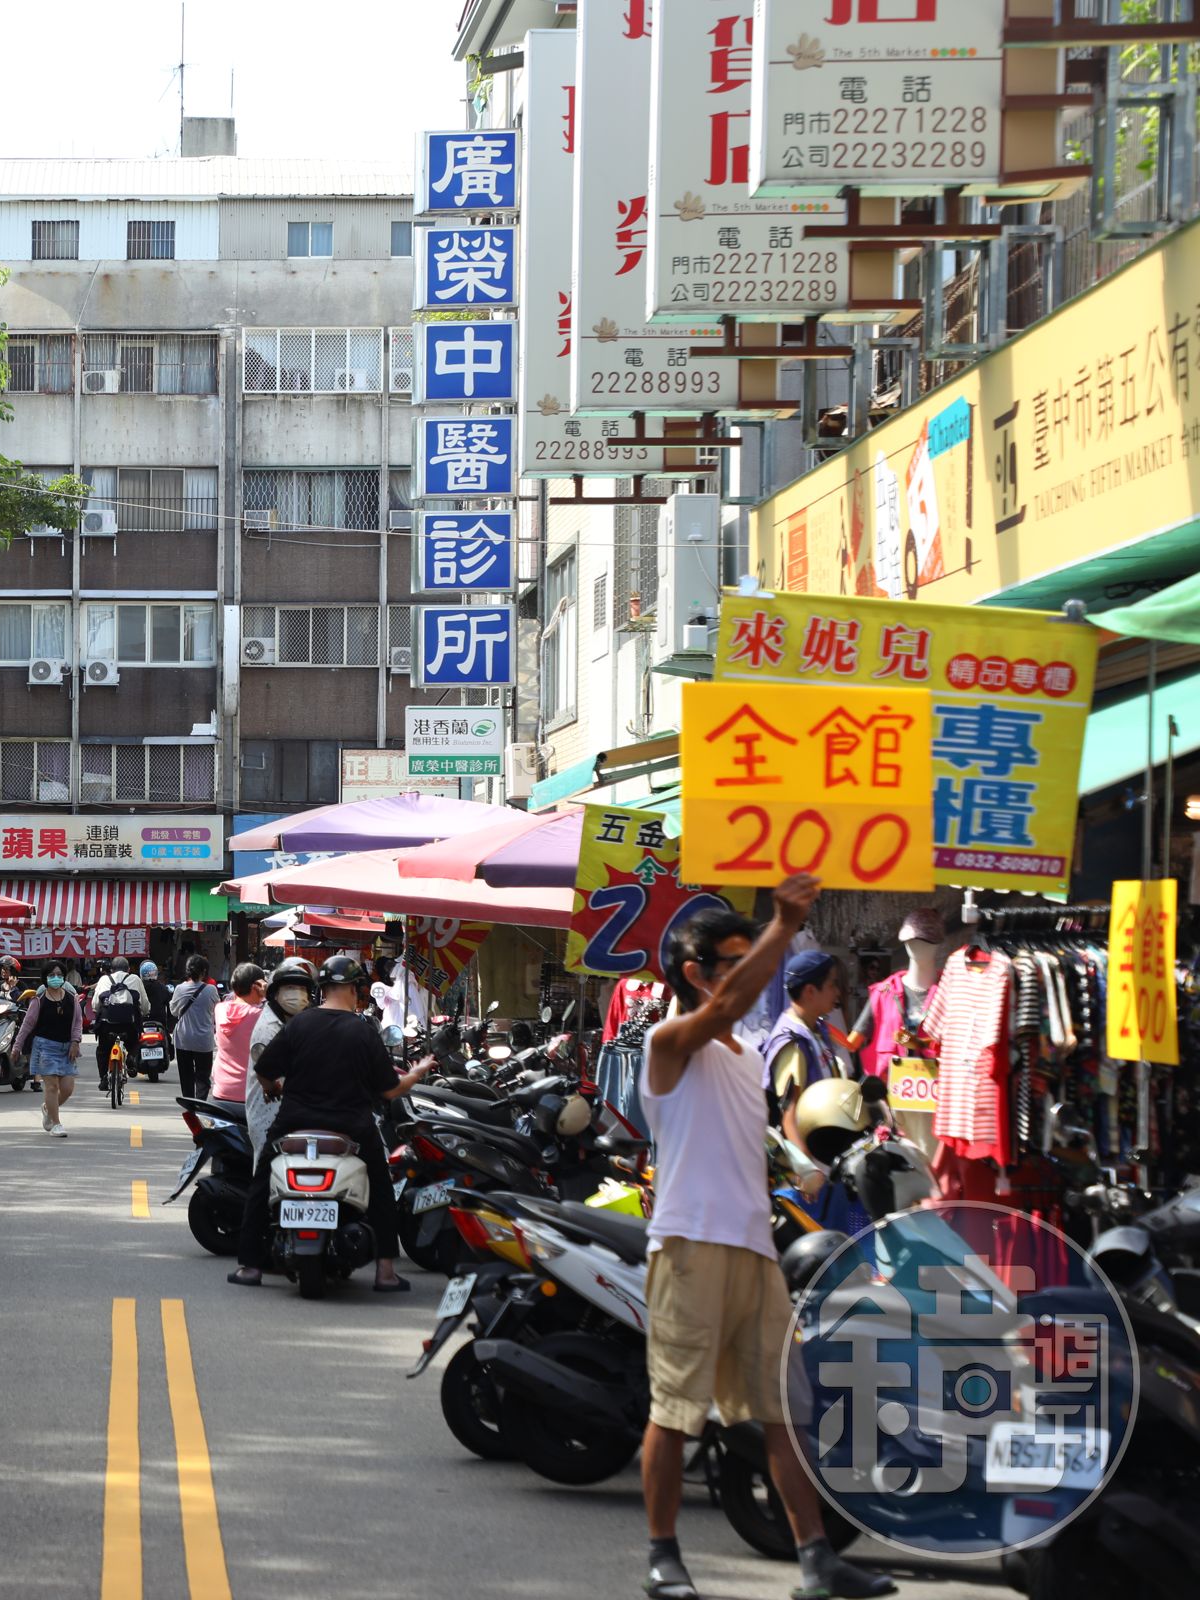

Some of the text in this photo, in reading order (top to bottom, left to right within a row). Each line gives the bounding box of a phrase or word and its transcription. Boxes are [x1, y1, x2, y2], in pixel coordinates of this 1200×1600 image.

[833, 47, 927, 58] The 5th Market
[591, 371, 720, 394] 22288993
[729, 610, 931, 682] 來妮兒
[413, 719, 469, 735] 港香蘭
[412, 737, 450, 746] 應用生技
[704, 702, 915, 790] 全館
[411, 759, 498, 773] 廣榮中醫診所
[86, 825, 119, 841] 連鎖
[2, 827, 68, 860] 蘋果
[73, 844, 133, 859] 精品童裝
[713, 804, 911, 884] 200
[1119, 982, 1167, 1043] 200
[282, 1207, 336, 1222] NUW-9228
